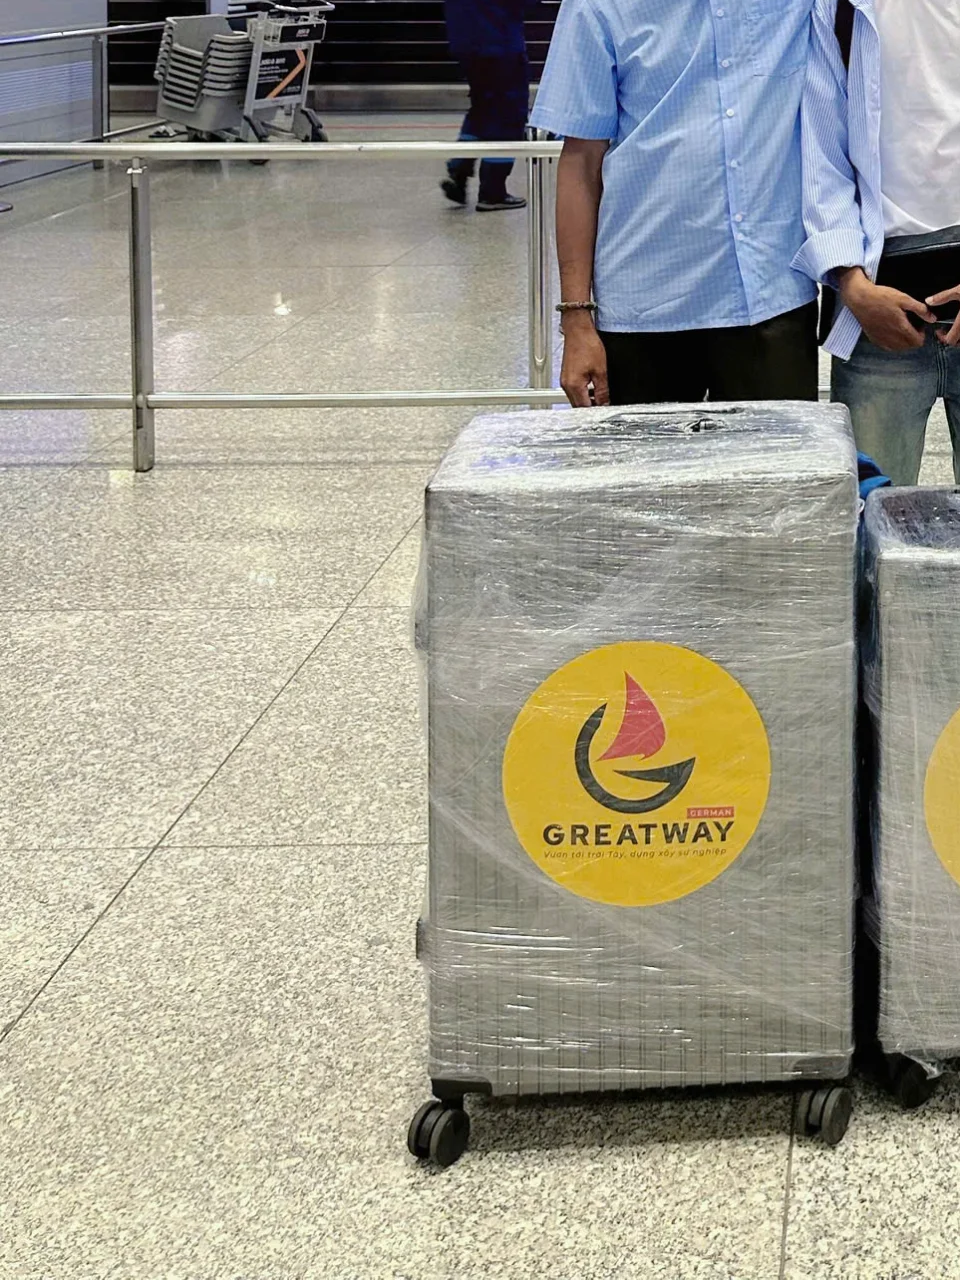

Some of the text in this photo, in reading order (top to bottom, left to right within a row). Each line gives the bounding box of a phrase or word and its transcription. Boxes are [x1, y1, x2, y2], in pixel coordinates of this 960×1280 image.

[690, 809, 732, 817] GERMAN
[543, 821, 734, 847] GREATWAY
[692, 848, 727, 857] nghiệp
